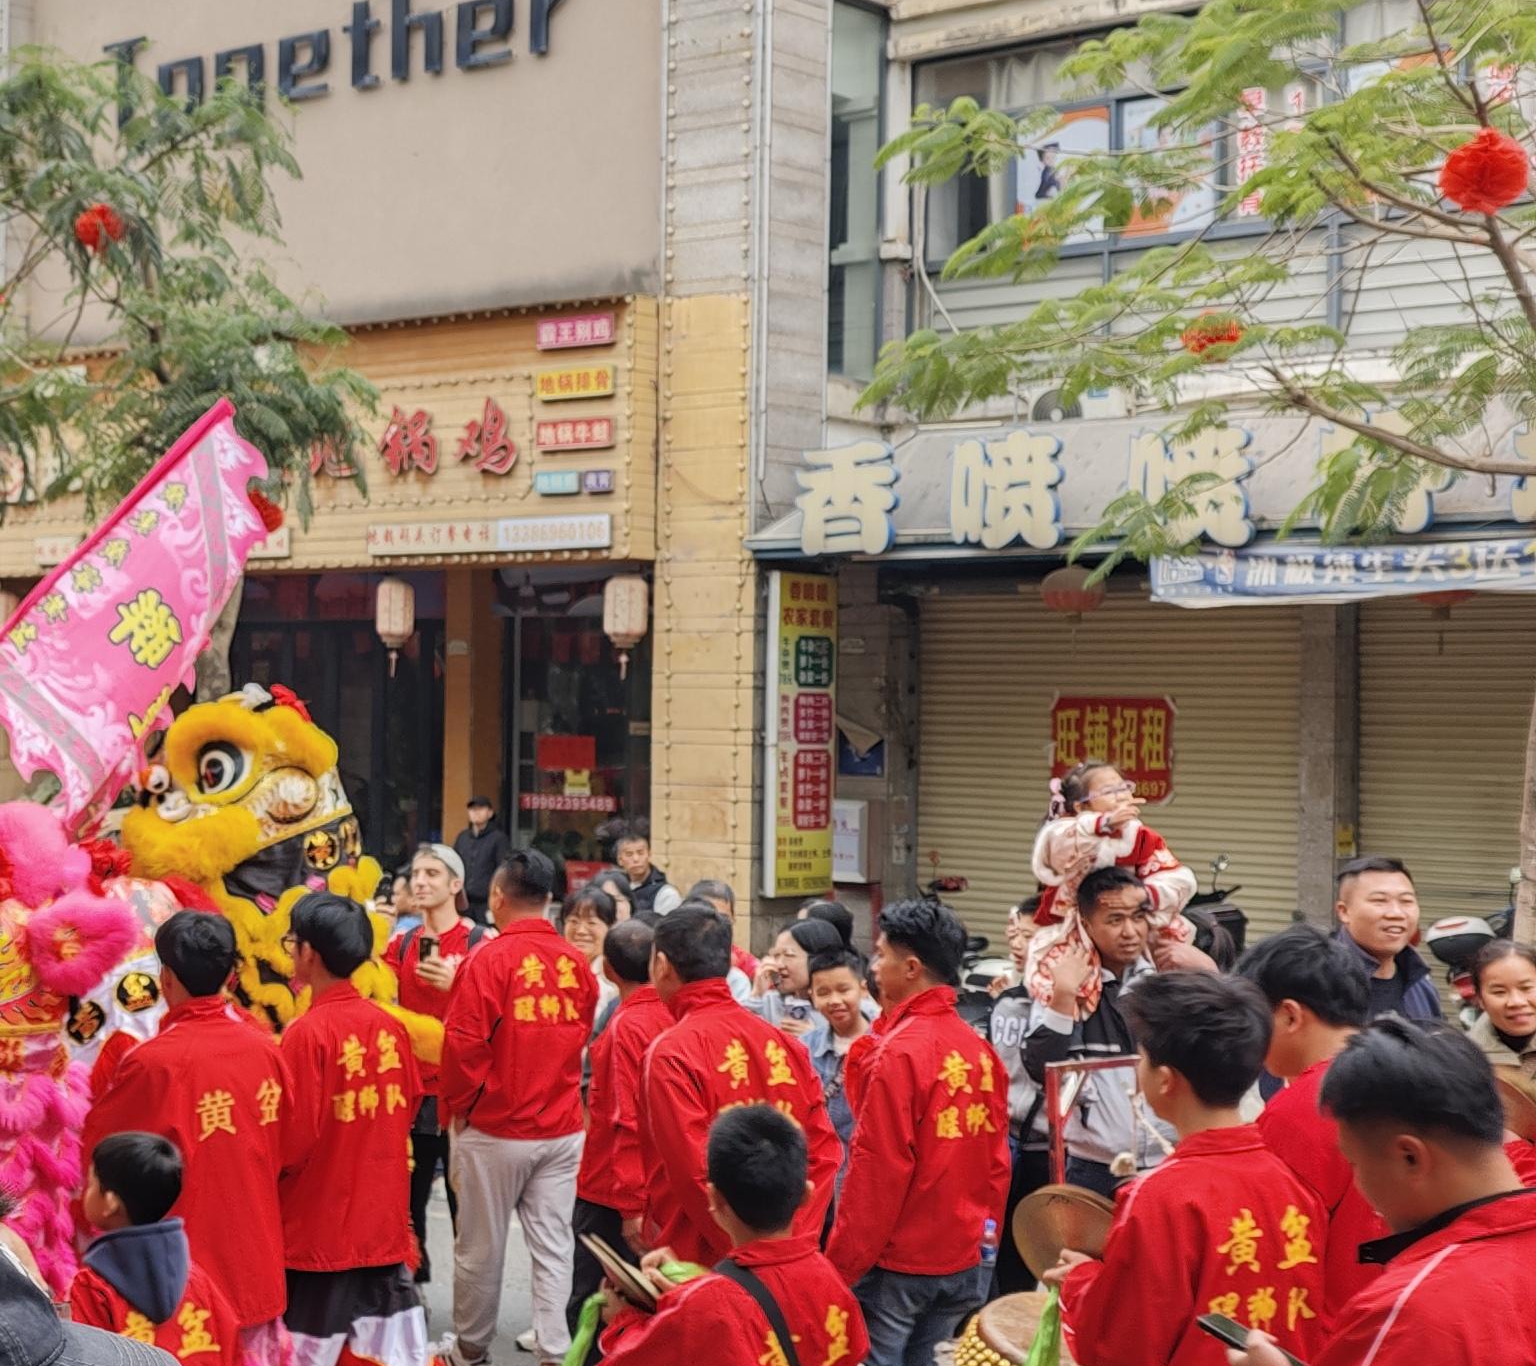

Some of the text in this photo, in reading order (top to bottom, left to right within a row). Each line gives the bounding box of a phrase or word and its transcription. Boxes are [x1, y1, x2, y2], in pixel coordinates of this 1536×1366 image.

[1055, 705, 1167, 772] 旺铺招租
[518, 953, 580, 991] 黄盆
[339, 1029, 403, 1078] 黄盆
[717, 1039, 796, 1087] 黄盆
[1217, 1204, 1316, 1274] 黄盆
